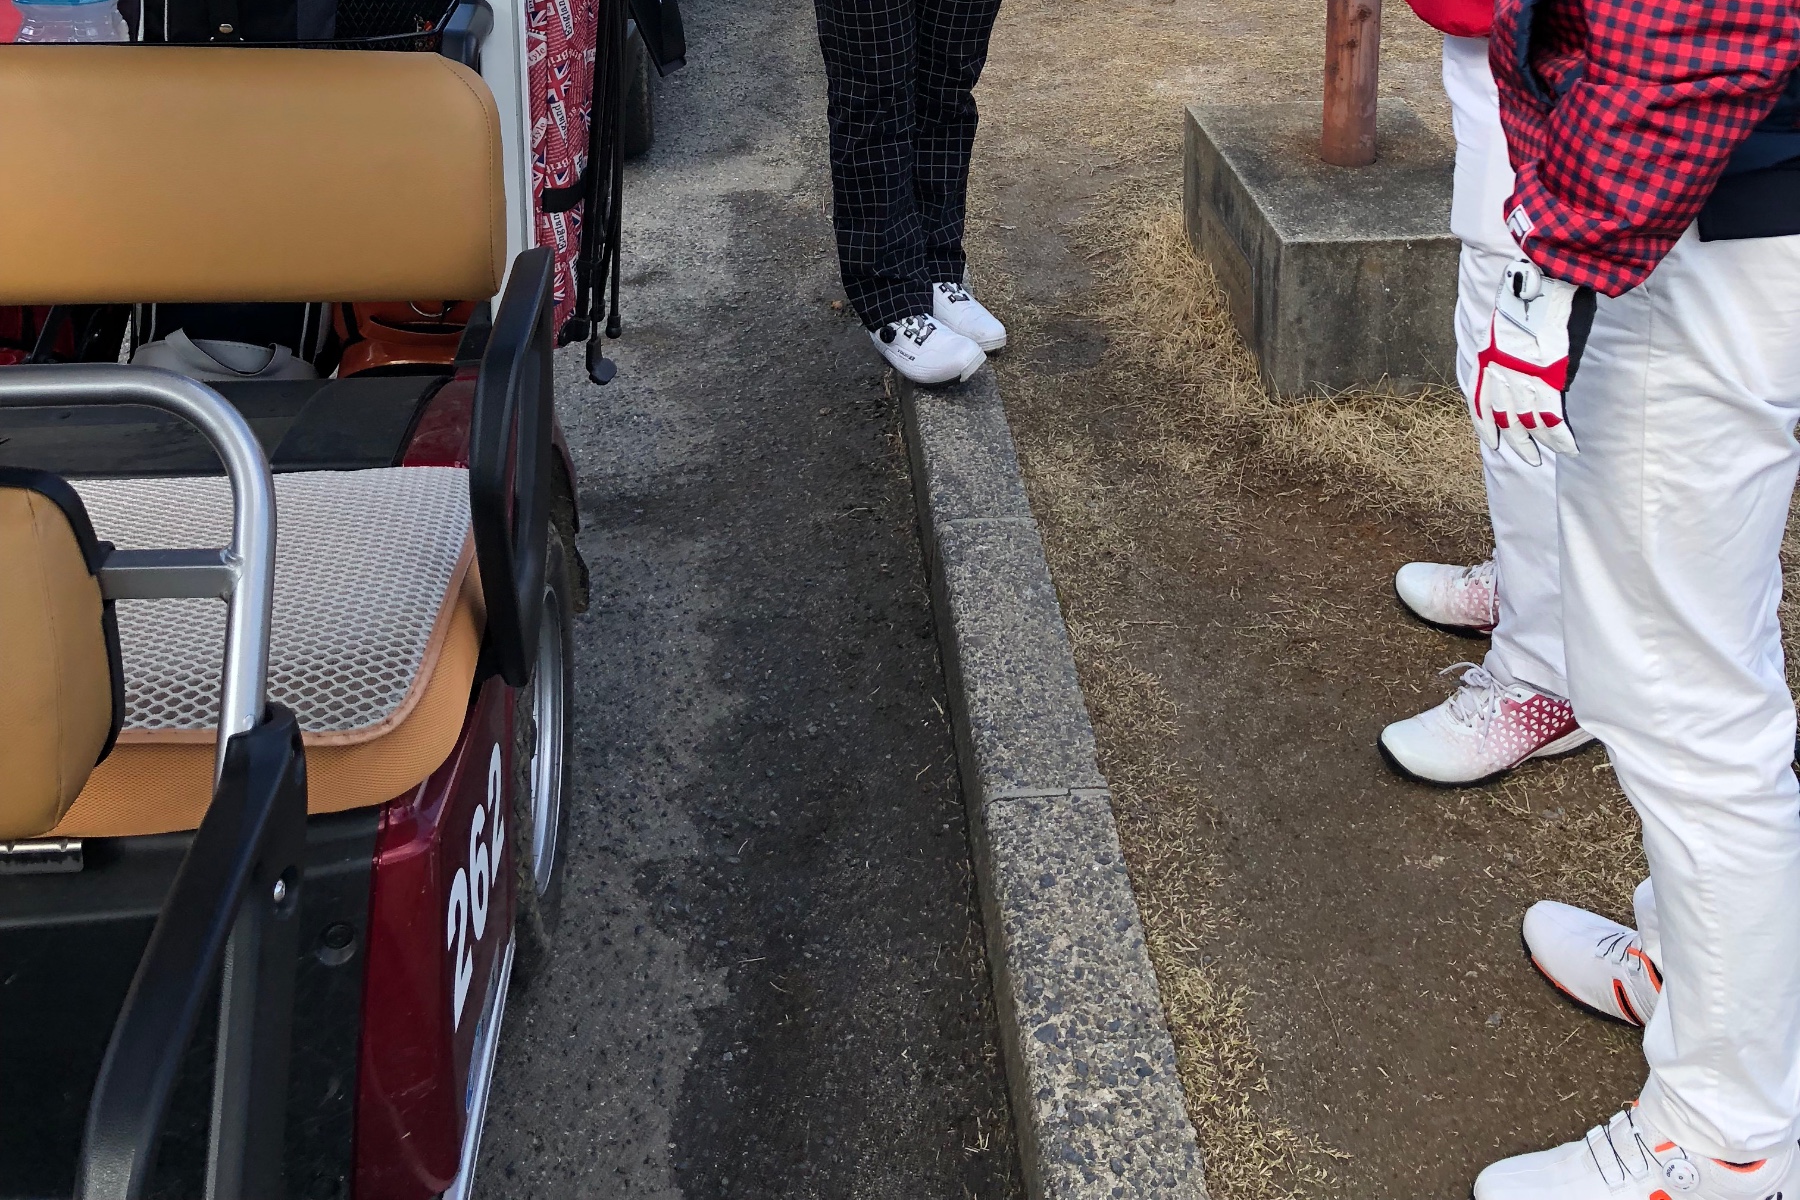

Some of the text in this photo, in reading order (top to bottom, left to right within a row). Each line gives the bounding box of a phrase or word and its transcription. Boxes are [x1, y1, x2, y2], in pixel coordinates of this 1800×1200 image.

[528, 46, 545, 61] tyle
[546, 157, 569, 174] Brit
[553, 212, 566, 250] Englan
[447, 742, 505, 1033] 262
